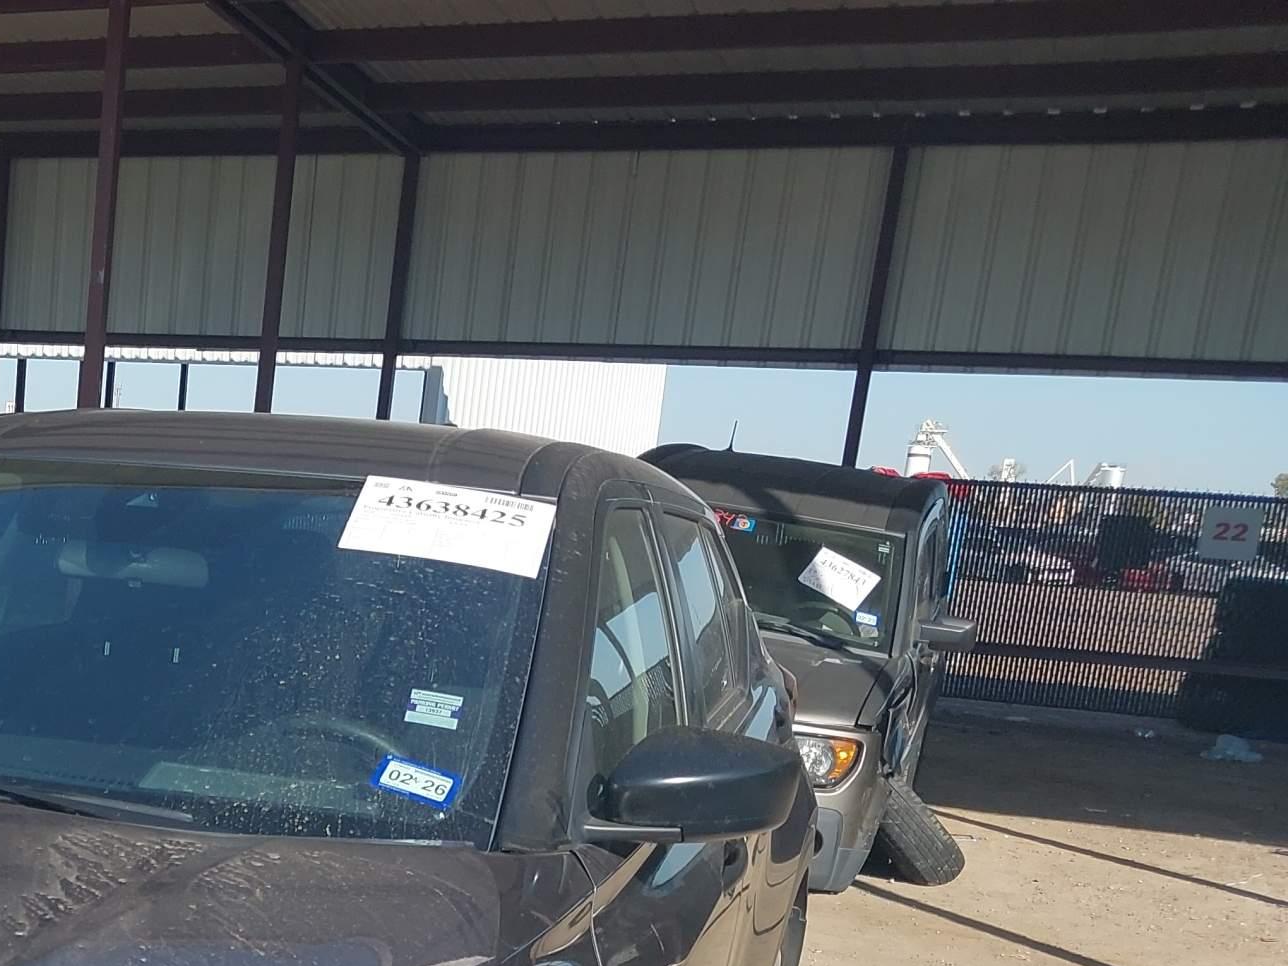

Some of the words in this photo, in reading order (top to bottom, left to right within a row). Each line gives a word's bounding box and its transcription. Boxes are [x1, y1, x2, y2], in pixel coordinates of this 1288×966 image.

[378, 494, 527, 528] 43638425
[1212, 522, 1249, 542] 22
[387, 769, 414, 786] 02
[420, 779, 448, 796] 26
